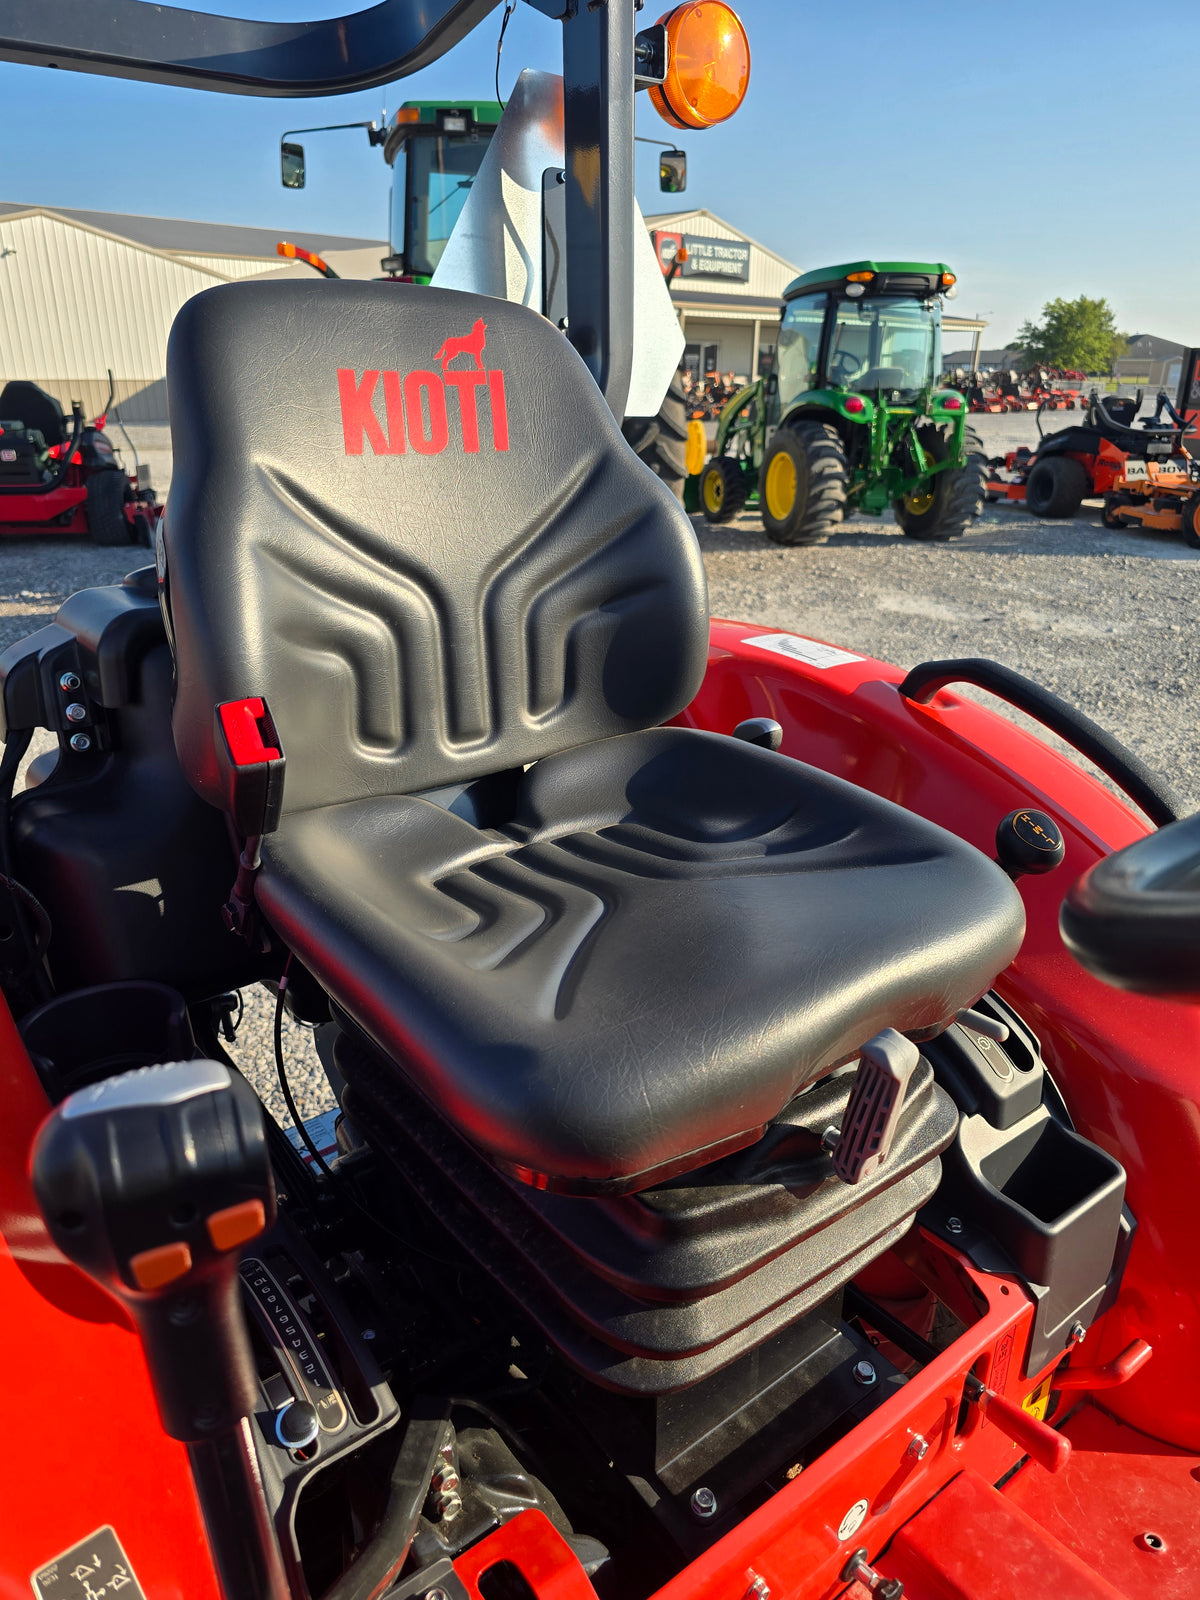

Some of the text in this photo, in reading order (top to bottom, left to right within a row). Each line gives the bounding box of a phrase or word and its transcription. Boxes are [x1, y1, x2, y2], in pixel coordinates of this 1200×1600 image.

[715, 246, 748, 261] TRACTOR
[691, 258, 743, 275] & EQUIPMENT
[337, 368, 510, 455] KIOTI
[254, 1277, 268, 1287] 10
[275, 1305, 283, 1314] 7
[286, 1326, 296, 1335] 5
[292, 1339, 301, 1347] 4
[299, 1351, 308, 1359] 3
[305, 1363, 315, 1373] 2
[314, 1378, 321, 1387] 1
